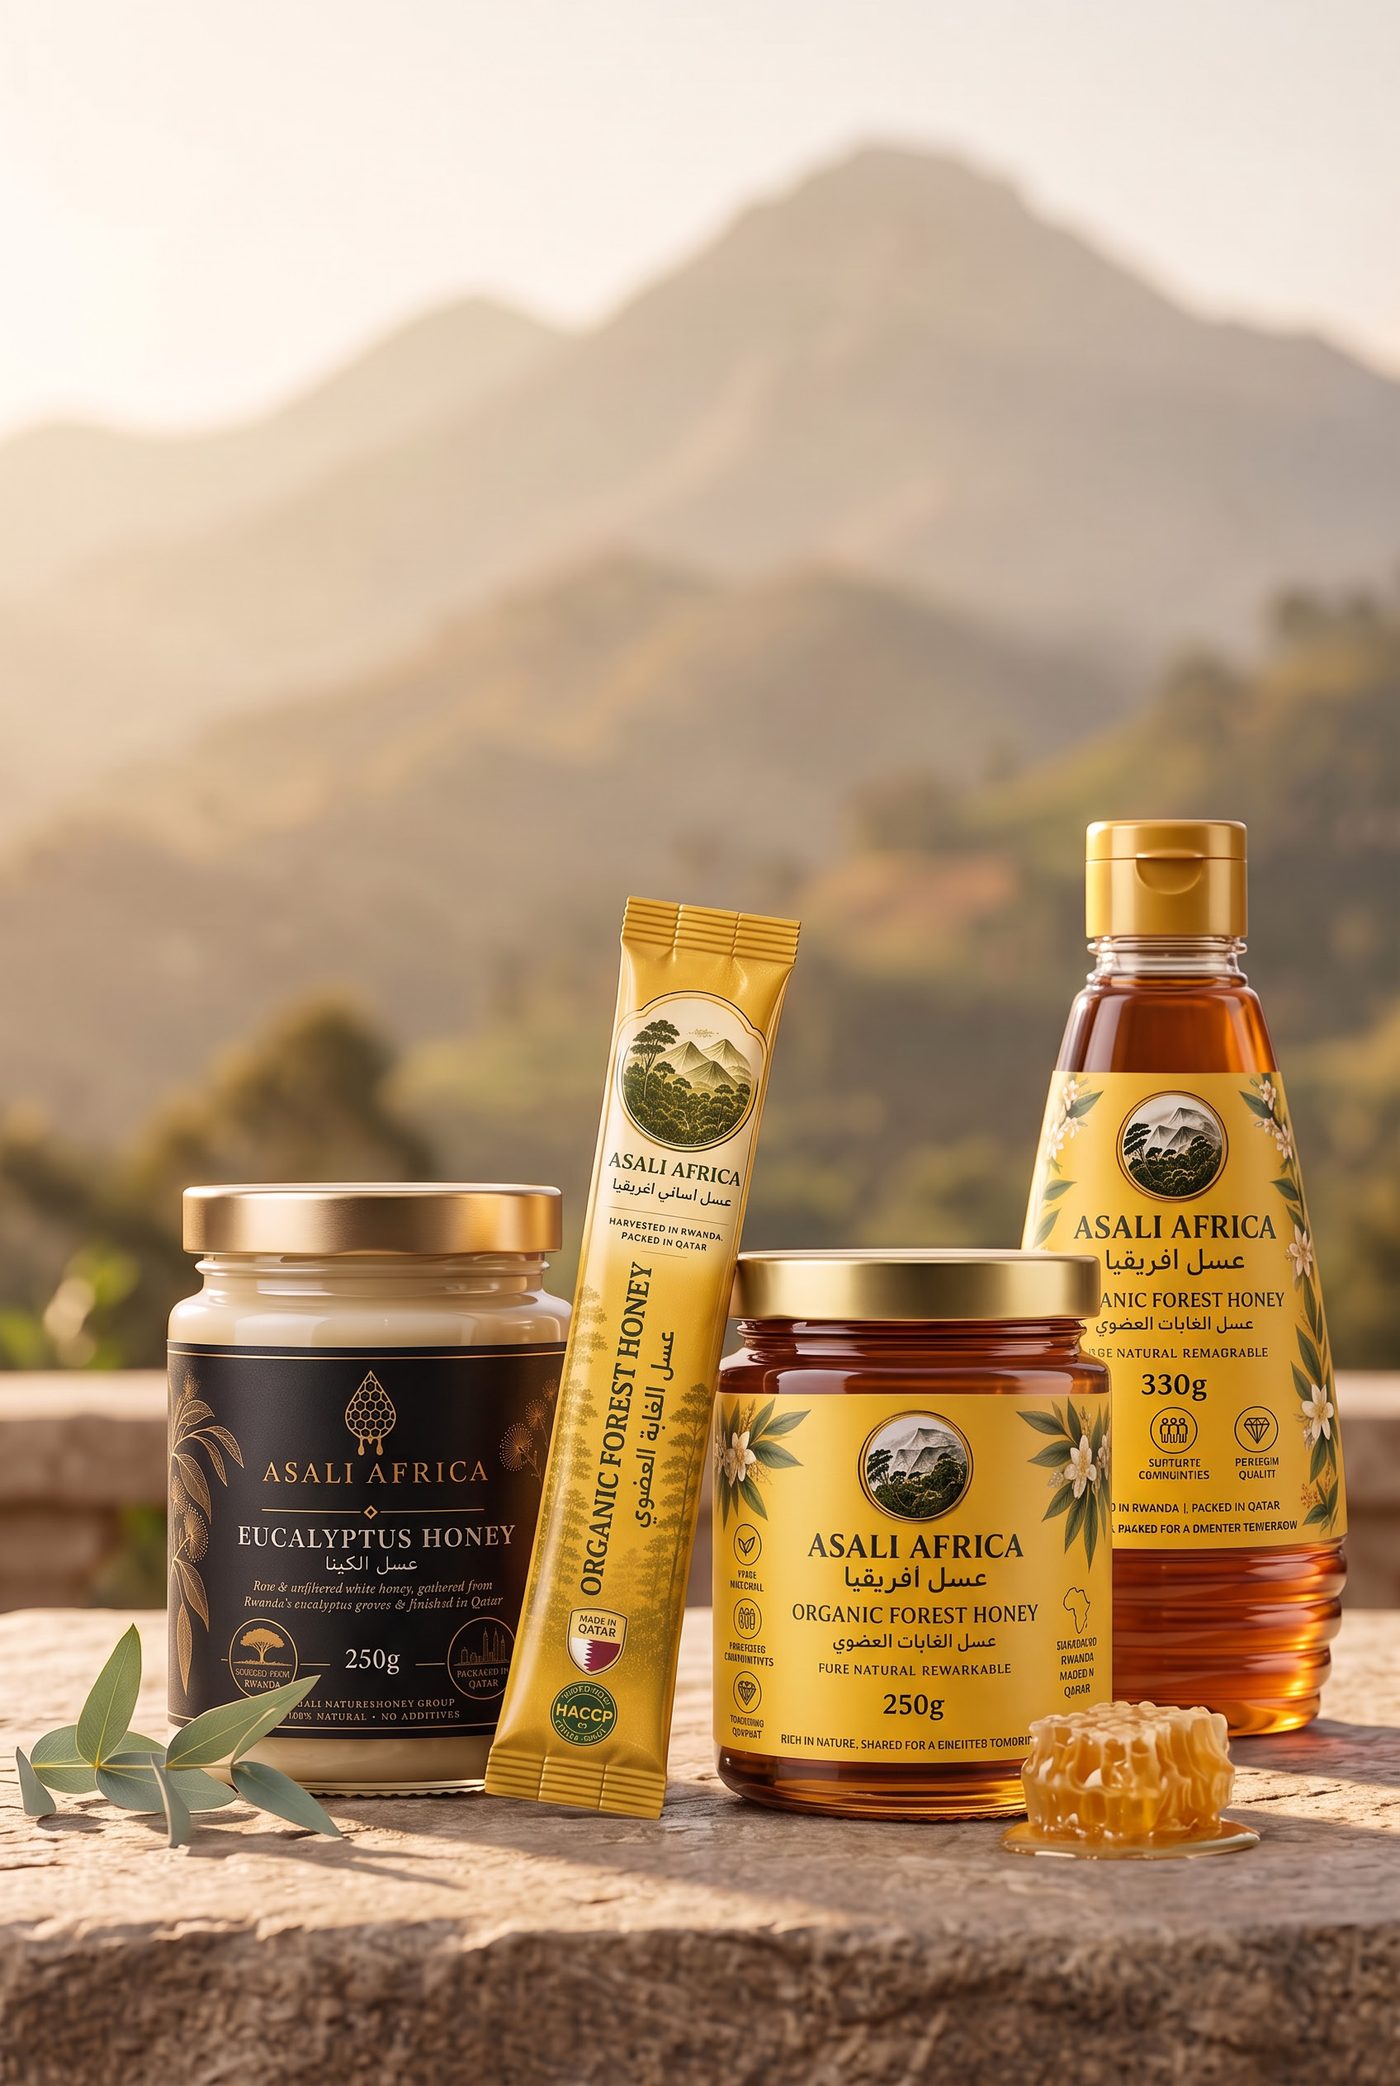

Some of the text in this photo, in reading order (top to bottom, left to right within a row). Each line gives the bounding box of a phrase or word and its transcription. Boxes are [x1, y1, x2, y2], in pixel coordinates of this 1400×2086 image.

[608, 1152, 741, 1187] ASALI AFRICA
[700, 1191, 731, 1206] عسل
[609, 1217, 666, 1233] HARVESTED
[668, 1226, 678, 1234] IN
[1073, 1215, 1277, 1239] ASALI AFRICA
[621, 1232, 707, 1251] PACKED IN QATAR
[1106, 1249, 1245, 1276] عسل افريقيا
[1152, 1292, 1223, 1308] FOREST
[1228, 1292, 1285, 1307] HONEY
[1095, 1316, 1254, 1337] عسل الغابات العضوي
[650, 1331, 674, 1381] عسل
[1117, 1348, 1178, 1358] NATURAL
[1141, 1373, 1207, 1401] 330g
[580, 1261, 652, 1596] ORGANIC FOREST HONEY
[262, 1460, 488, 1484] ASALI AFRICA
[1119, 1503, 1129, 1512] IN
[1132, 1503, 1179, 1513] RWANDA
[1191, 1503, 1232, 1513] PACKED
[1234, 1502, 1245, 1511] IN
[1247, 1501, 1280, 1512] QATAR
[237, 1524, 516, 1549] EUCALYPTUS HONEY
[1160, 1524, 1181, 1534] FOR
[1182, 1524, 1190, 1534] A
[807, 1533, 1024, 1559] ASALI AFRICA
[376, 1556, 418, 1575] عسل
[278, 1581, 288, 1592] &
[345, 1583, 376, 1594] white
[465, 1579, 493, 1595] from
[928, 1567, 987, 1593] عسل
[354, 1600, 391, 1613] groves
[395, 1599, 406, 1610] &
[456, 1597, 468, 1608] in
[792, 1603, 1039, 1624] ORGANIC FOREST HONEY
[579, 1615, 617, 1626] MADE IN
[578, 1623, 616, 1638] QATAR
[832, 1633, 997, 1654] عسل الغابات العضوي
[345, 1648, 401, 1675] 250g
[1061, 1652, 1094, 1665] RWANDA
[853, 1664, 916, 1676] NATURAL
[244, 1680, 281, 1689] RWANDA
[468, 1679, 499, 1690] QATAR
[417, 1698, 455, 1708] GROUP
[883, 1694, 945, 1721] 250g
[316, 1712, 367, 1721] NATURAL
[381, 1712, 397, 1720] NO
[401, 1710, 460, 1720] ADDITIVES
[556, 1703, 613, 1723] HACCP
[780, 1733, 801, 1745] RICH
[804, 1736, 814, 1746] IN
[816, 1737, 859, 1750] NATURE,
[861, 1739, 903, 1750] SHARED
[905, 1740, 925, 1750] FOR
[928, 1740, 935, 1750] A
